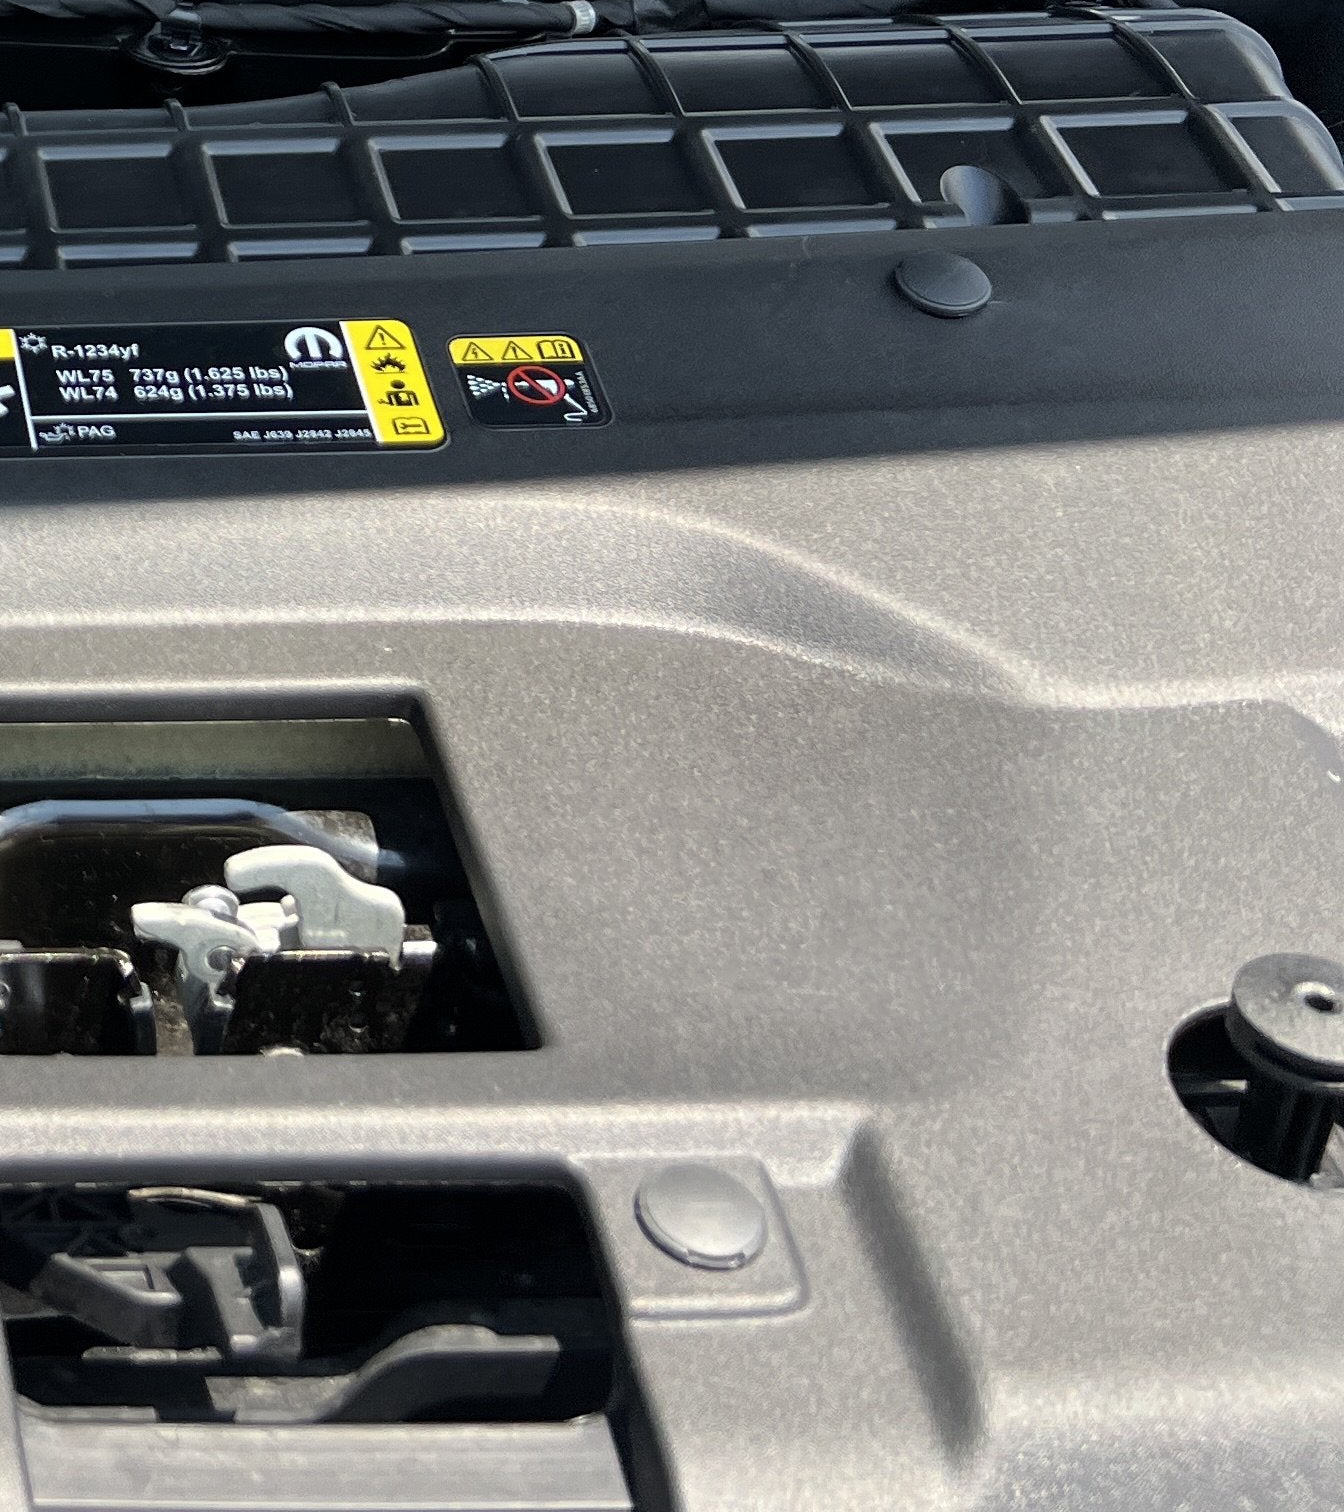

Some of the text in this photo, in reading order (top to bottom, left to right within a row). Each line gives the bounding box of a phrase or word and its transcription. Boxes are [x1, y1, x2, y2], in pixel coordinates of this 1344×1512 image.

[51, 343, 140, 361] R-1234yf
[288, 360, 348, 369] MOPAR
[55, 364, 289, 386] WL75 737g (1.625 lbs)
[58, 383, 295, 404] WL74 624g (1.375 lbs)
[76, 424, 117, 439] PAG
[232, 430, 261, 440] SAE
[263, 430, 294, 440] J639
